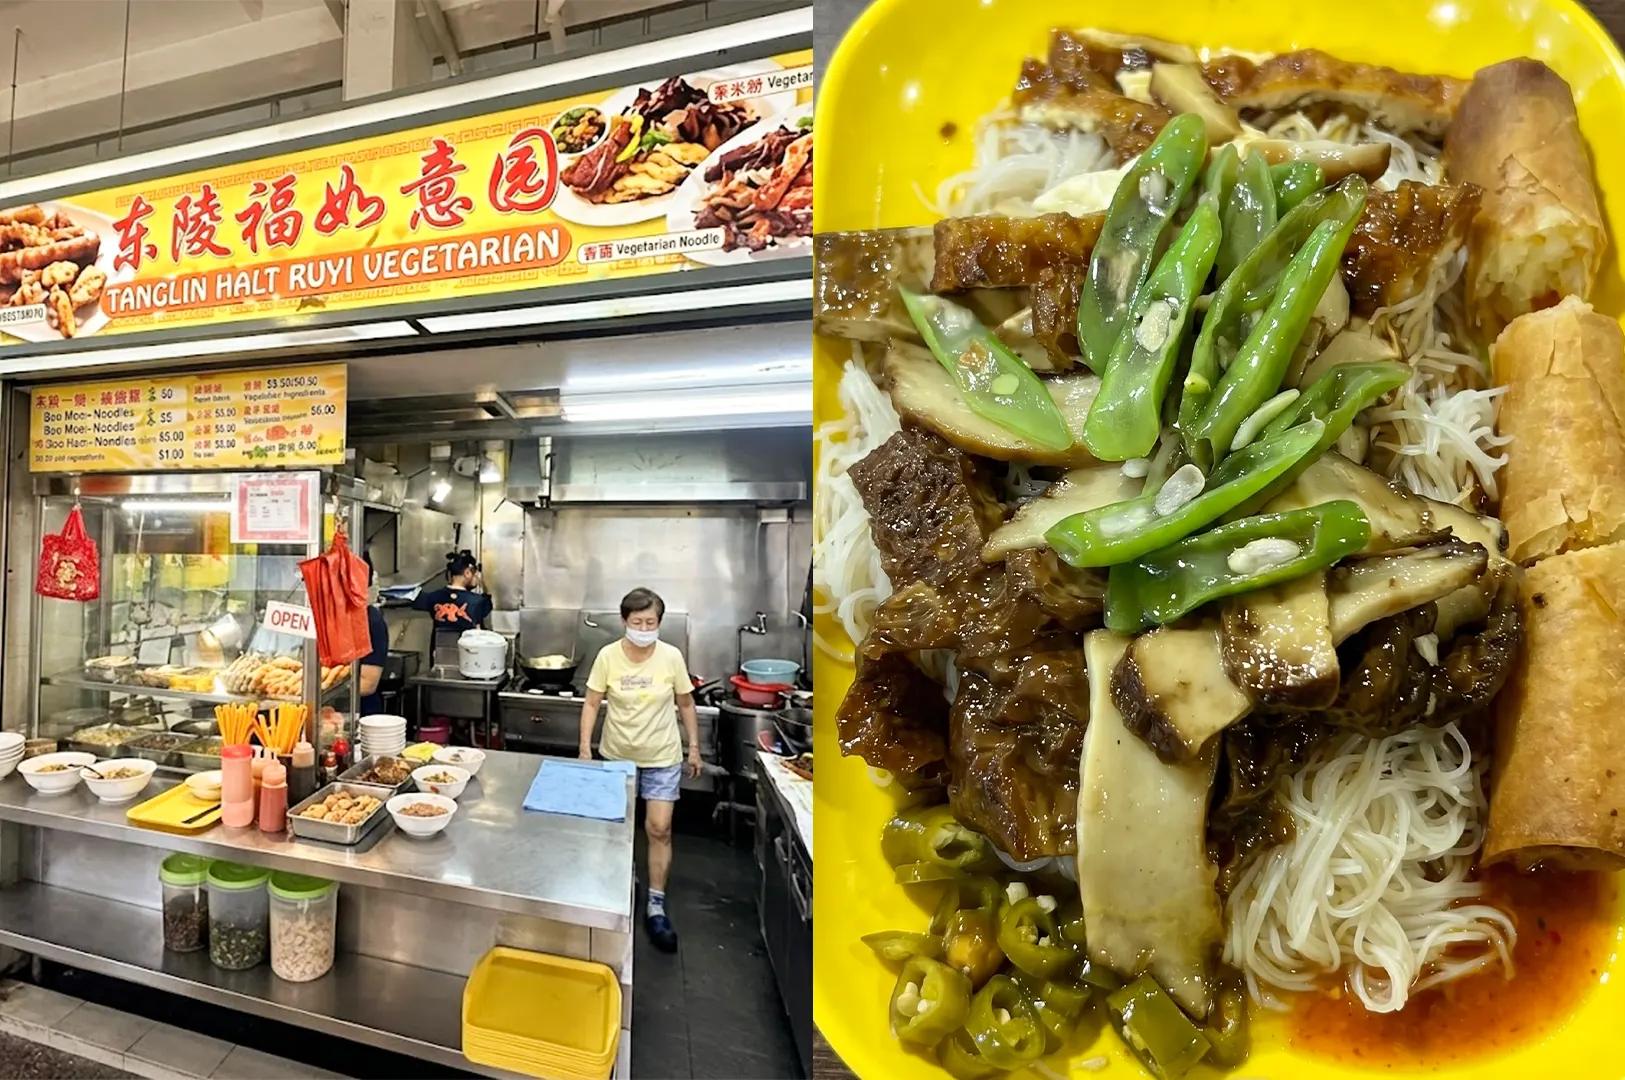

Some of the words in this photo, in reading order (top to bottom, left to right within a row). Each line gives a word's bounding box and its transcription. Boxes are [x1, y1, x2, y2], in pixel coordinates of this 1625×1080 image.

[111, 128, 559, 271] 东陵福如意园
[616, 239, 676, 255] Vegetarian
[679, 233, 720, 248] Noodle
[106, 278, 208, 313] TANGLIN
[216, 266, 281, 301] HALT
[288, 256, 354, 291] RUYI
[362, 229, 560, 282] VEGETARIAN
[271, 610, 310, 632] OPEN
